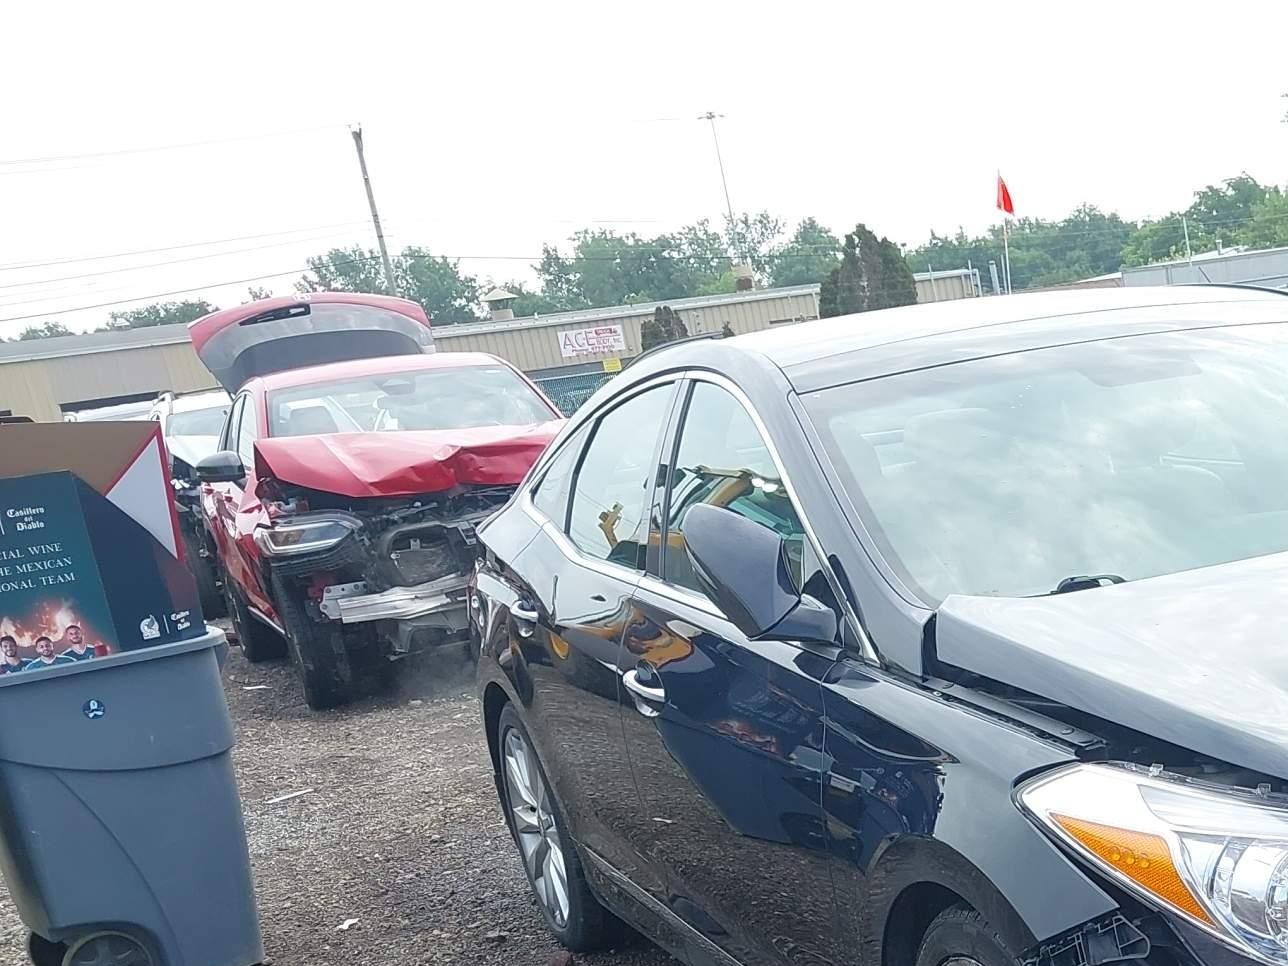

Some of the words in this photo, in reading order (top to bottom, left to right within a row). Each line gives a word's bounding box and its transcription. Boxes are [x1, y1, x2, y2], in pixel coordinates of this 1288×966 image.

[563, 330, 595, 349] ACE
[16, 521, 45, 531] Diablo
[0, 549, 24, 560] IAL
[28, 543, 63, 555] WINE
[16, 557, 72, 574] MEXICAN
[40, 572, 75, 586] TEAM
